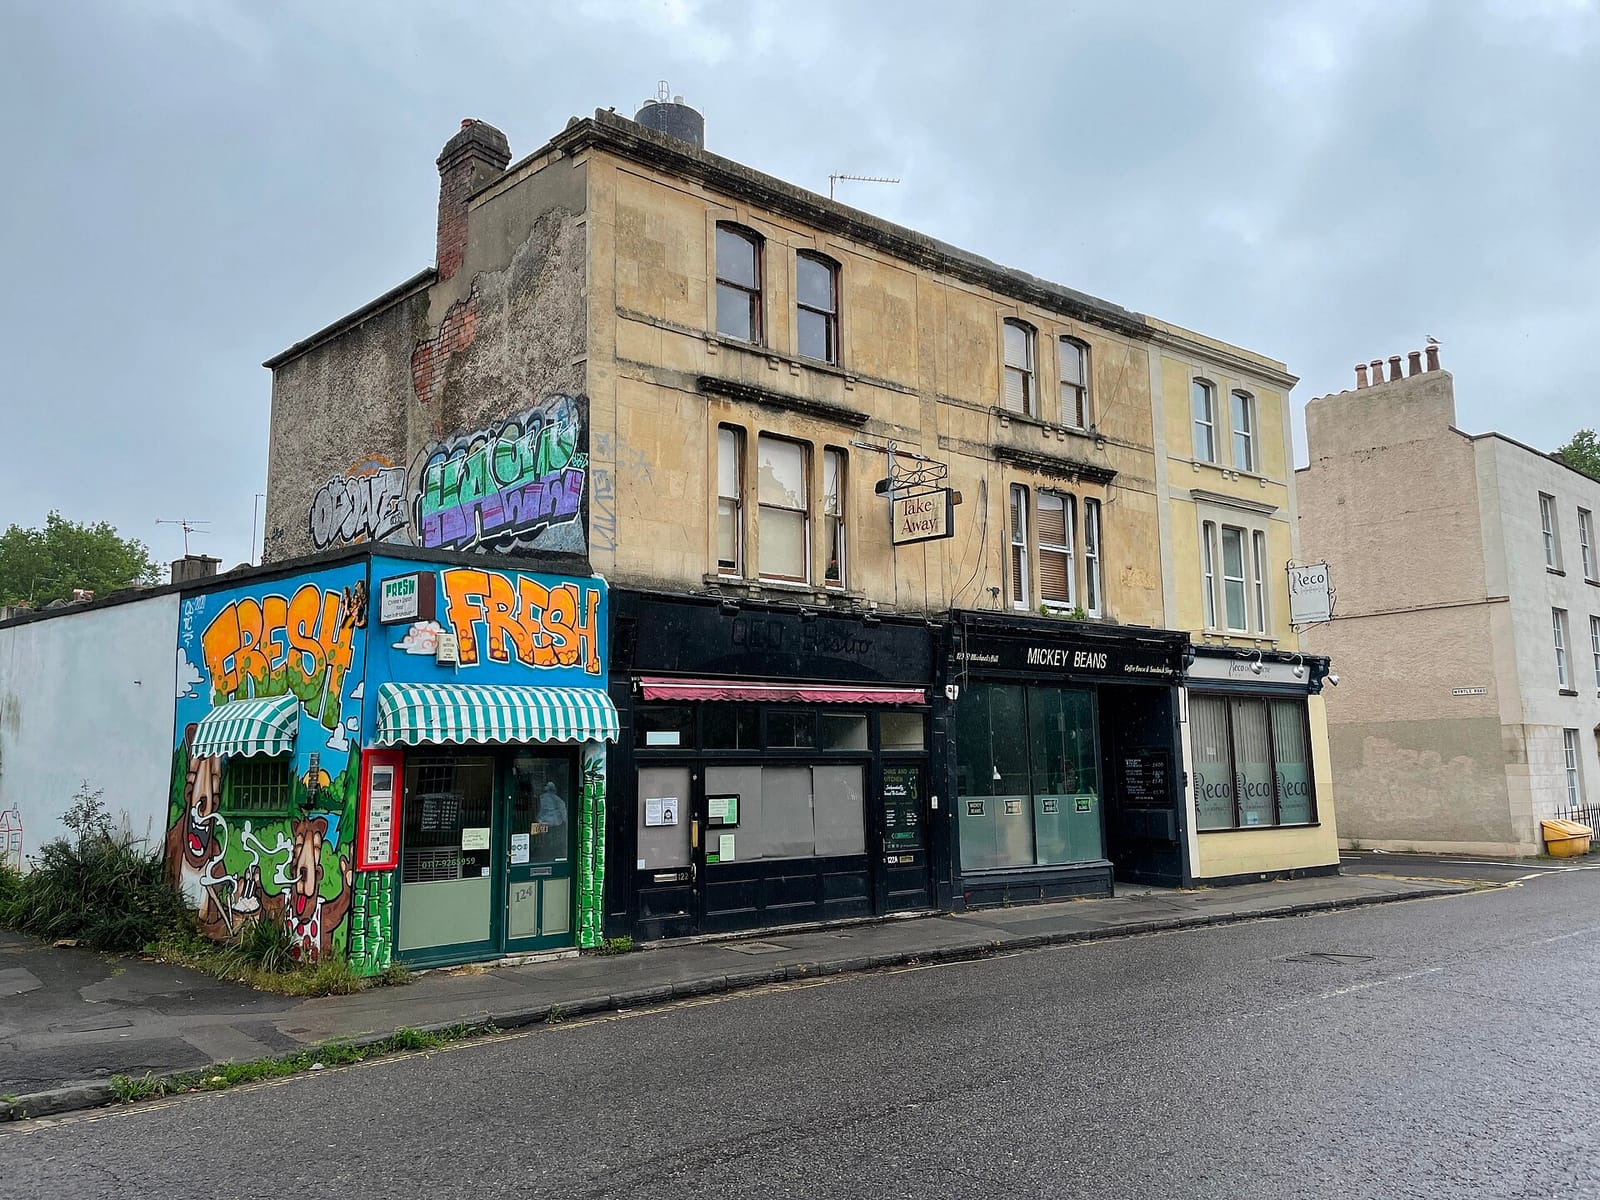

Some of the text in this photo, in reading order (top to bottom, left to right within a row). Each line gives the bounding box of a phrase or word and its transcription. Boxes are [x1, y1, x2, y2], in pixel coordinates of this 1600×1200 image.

[902, 499, 932, 516] Take
[901, 518, 936, 534] Away
[386, 579, 415, 598] FRESH
[1292, 571, 1325, 588] Reco
[441, 567, 600, 675] FRESH
[202, 584, 355, 729] FRESH
[1027, 647, 1107, 669] MICKEY BEANS
[1194, 772, 1230, 803] Reco
[1236, 772, 1270, 801] Reco
[1276, 772, 1308, 800] Reco
[421, 857, 476, 869] 0117-9265959
[514, 886, 533, 902] 124
